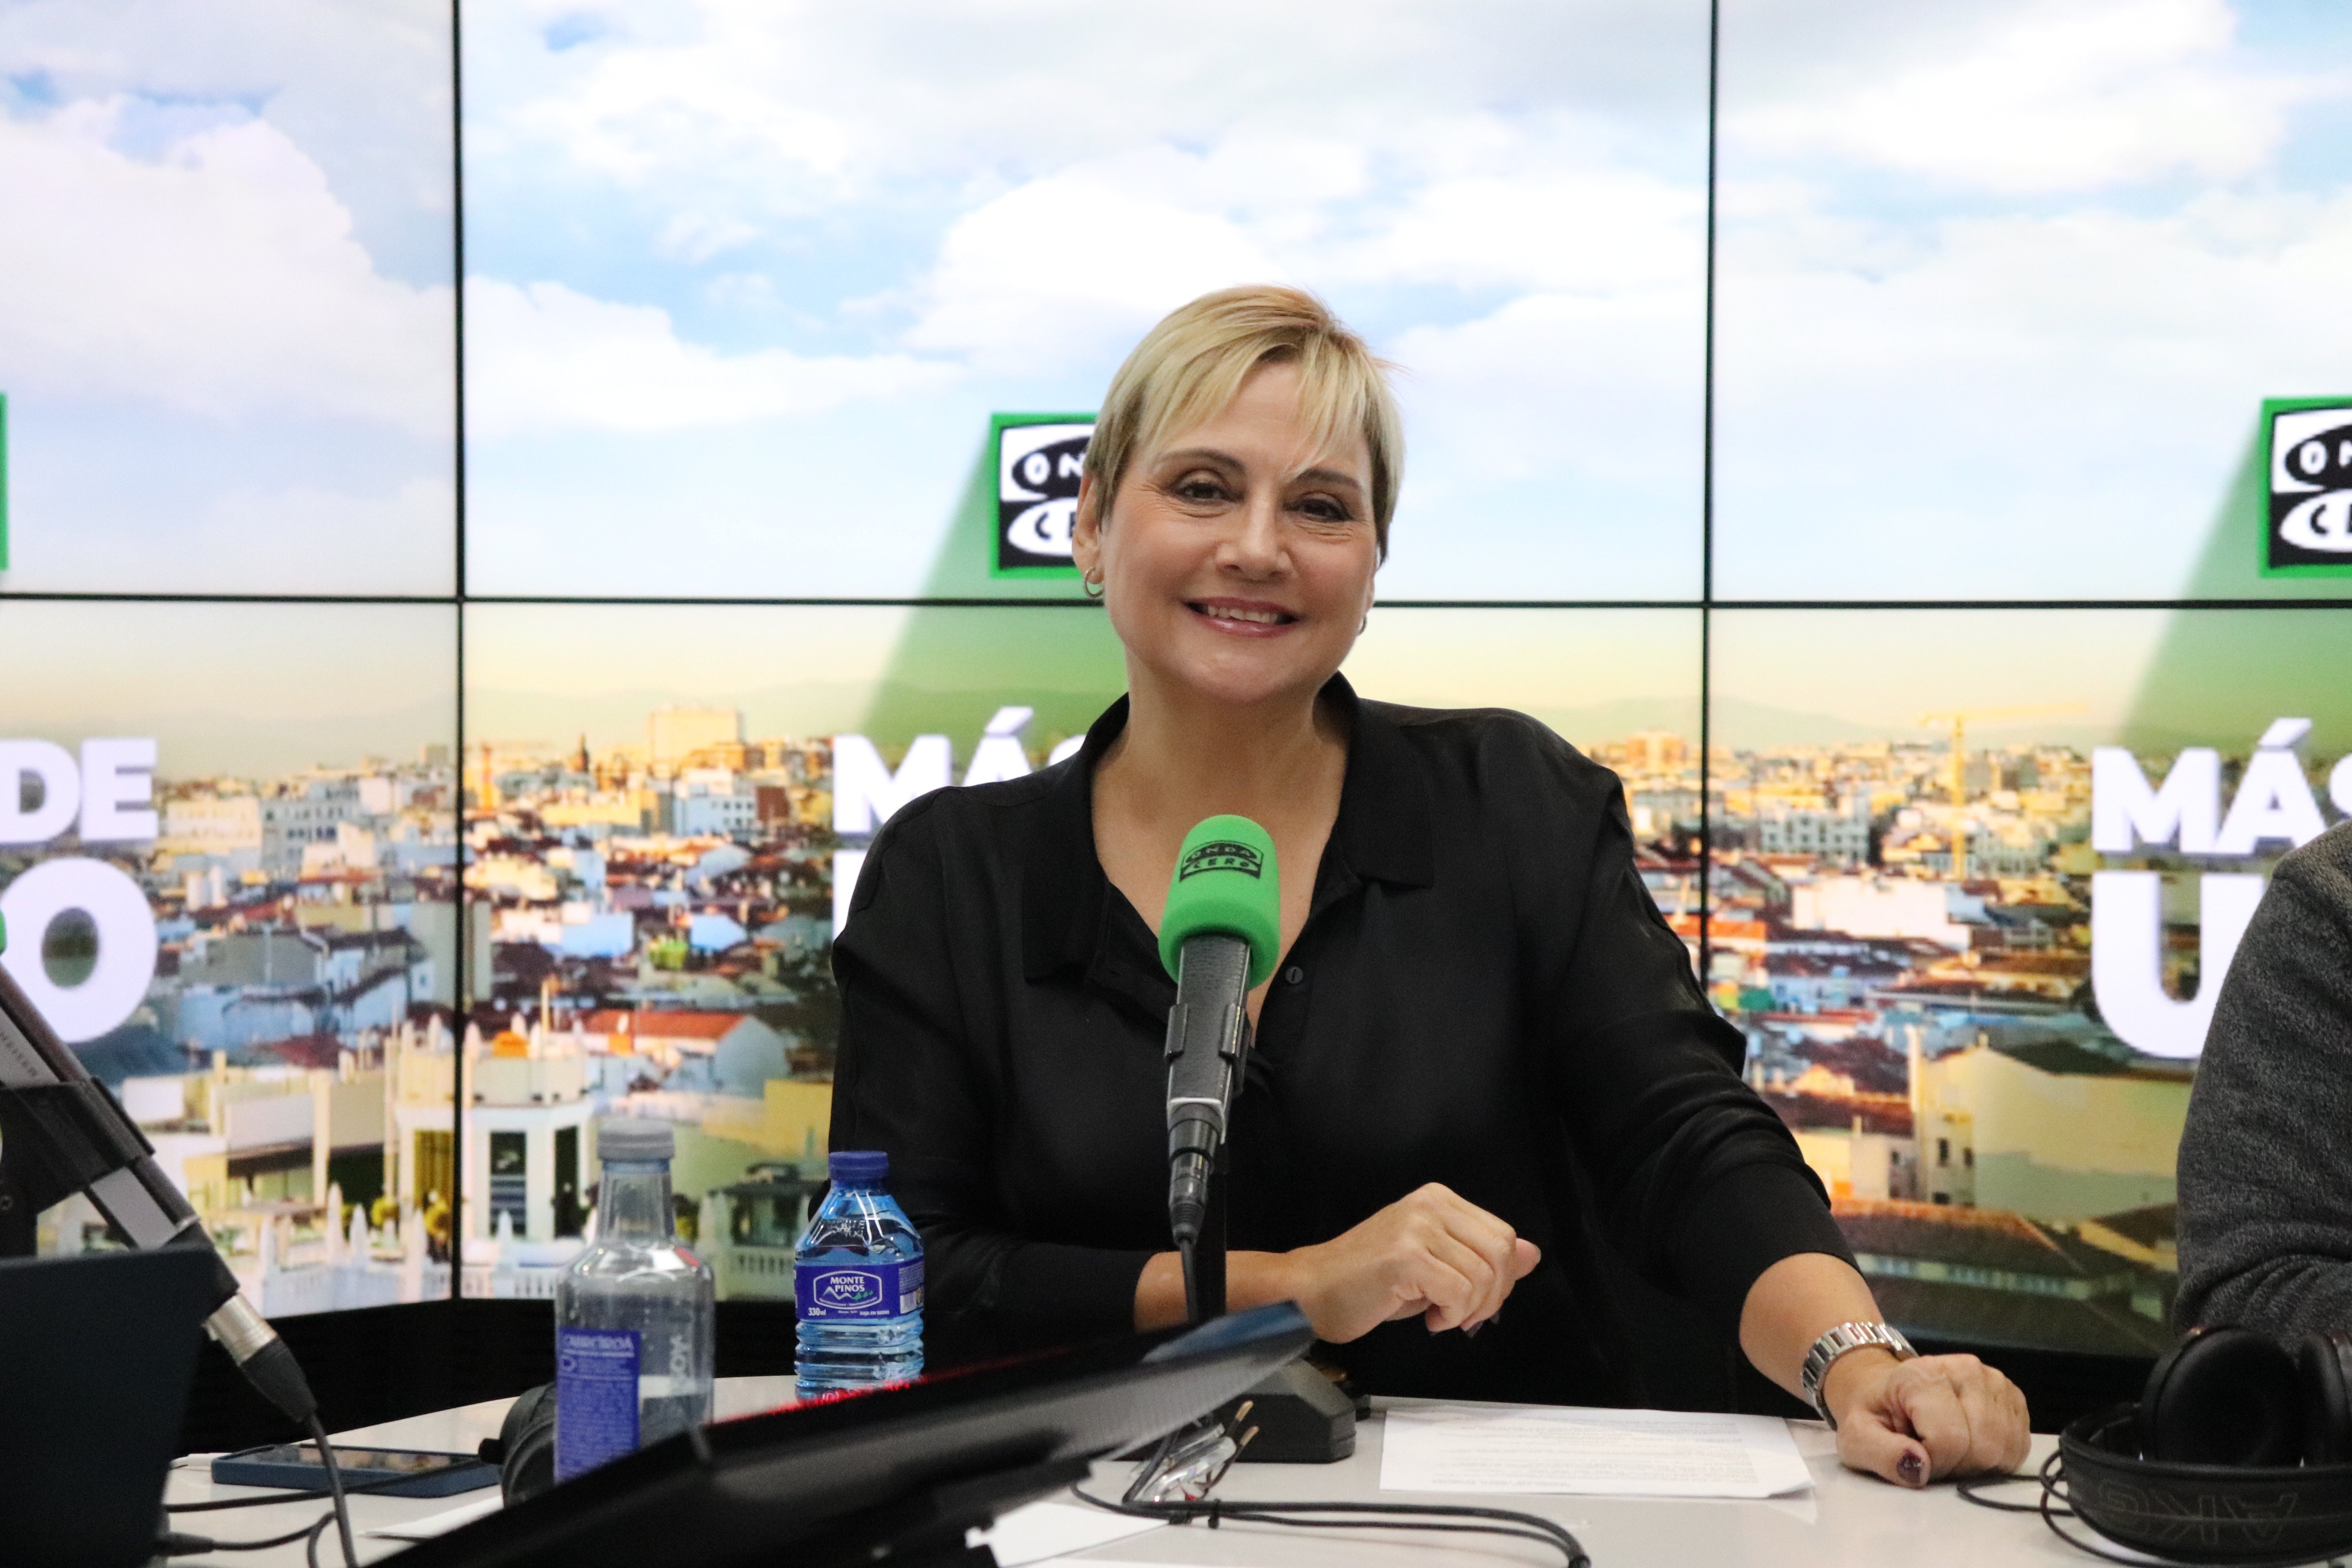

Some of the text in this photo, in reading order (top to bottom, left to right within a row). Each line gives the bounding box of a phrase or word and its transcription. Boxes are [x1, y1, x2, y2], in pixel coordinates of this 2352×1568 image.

[0, 739, 156, 842] DE
[833, 706, 1087, 832] MÁ
[1191, 845, 1251, 859] ONDA
[830, 1276, 865, 1285] MONTE
